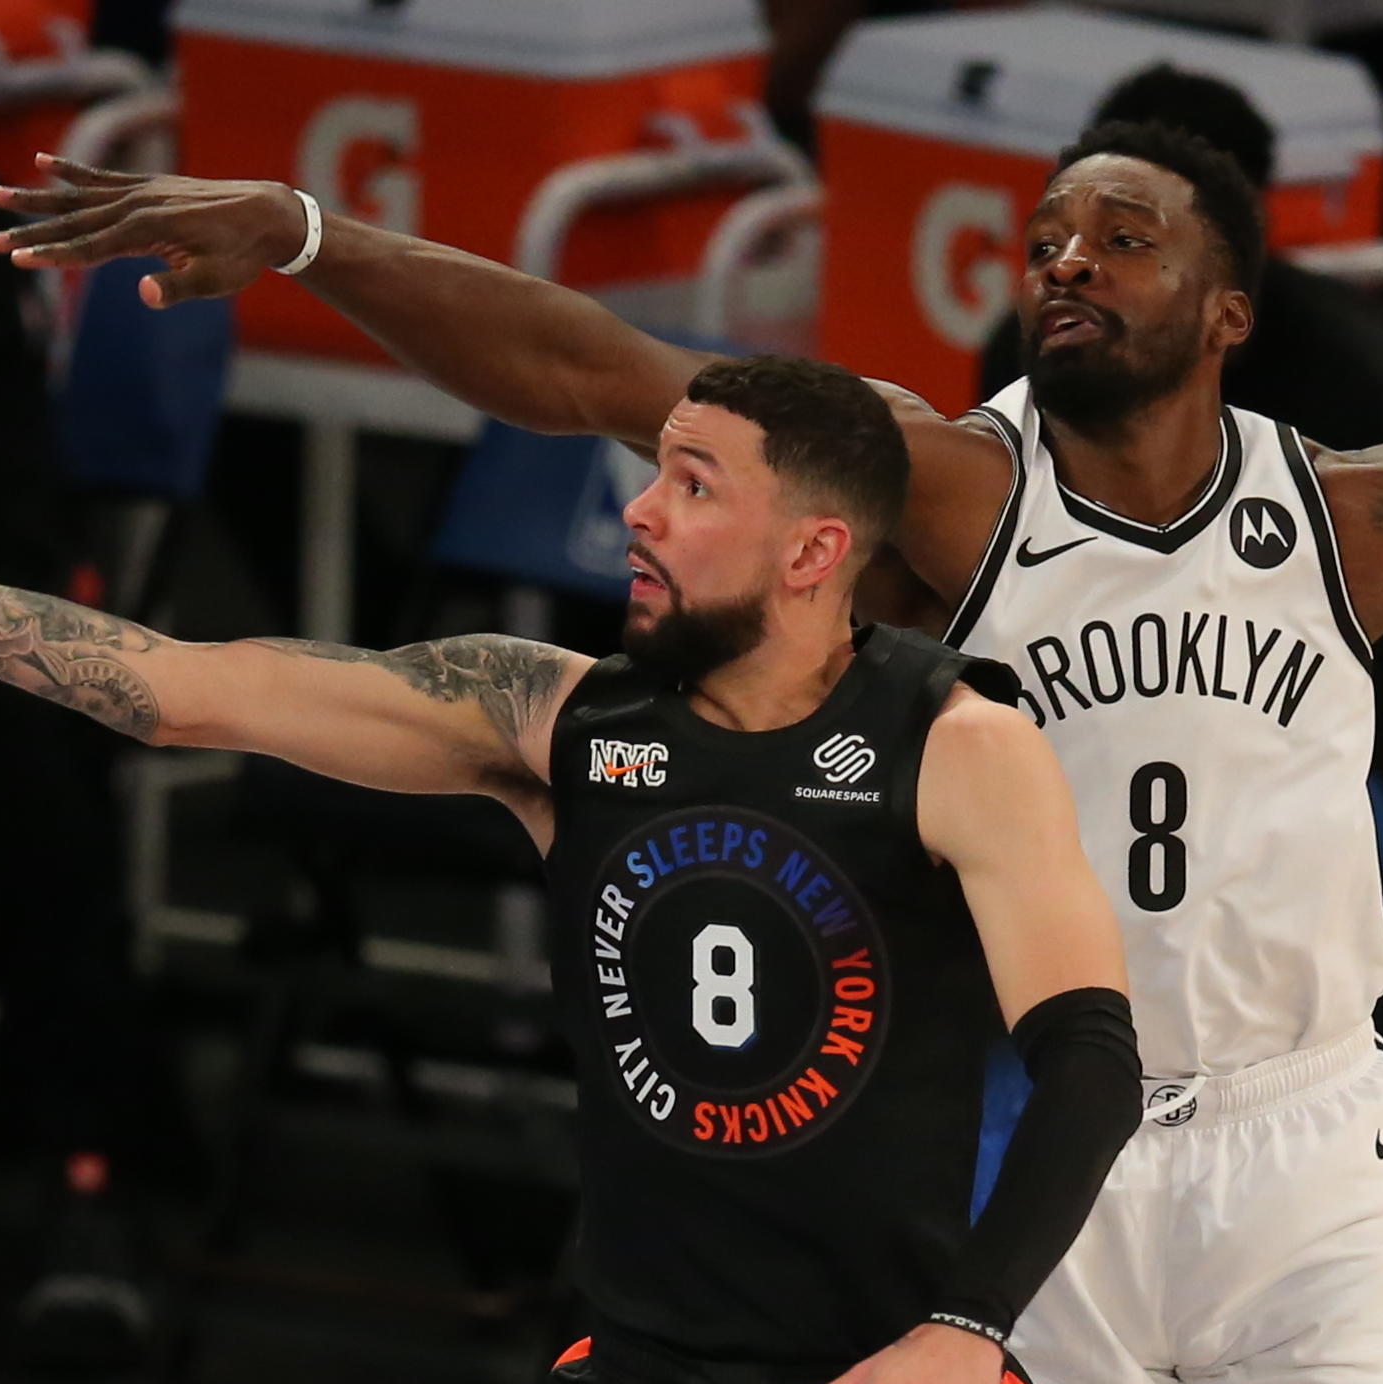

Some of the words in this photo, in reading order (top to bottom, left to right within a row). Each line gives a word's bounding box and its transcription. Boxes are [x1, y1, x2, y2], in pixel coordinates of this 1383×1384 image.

[911, 182, 1015, 351] G
[588, 739, 669, 788] NYC
[794, 786, 881, 803] SQUARESPACE
[625, 821, 768, 889] SLEEPS
[1129, 761, 1188, 913] 8
[775, 849, 859, 939] NEW
[593, 883, 635, 1020] NEVER
[692, 923, 756, 1050] 8
[820, 946, 876, 1067] YORK
[614, 1036, 677, 1122] CITY
[693, 1066, 839, 1144] KNICKS
